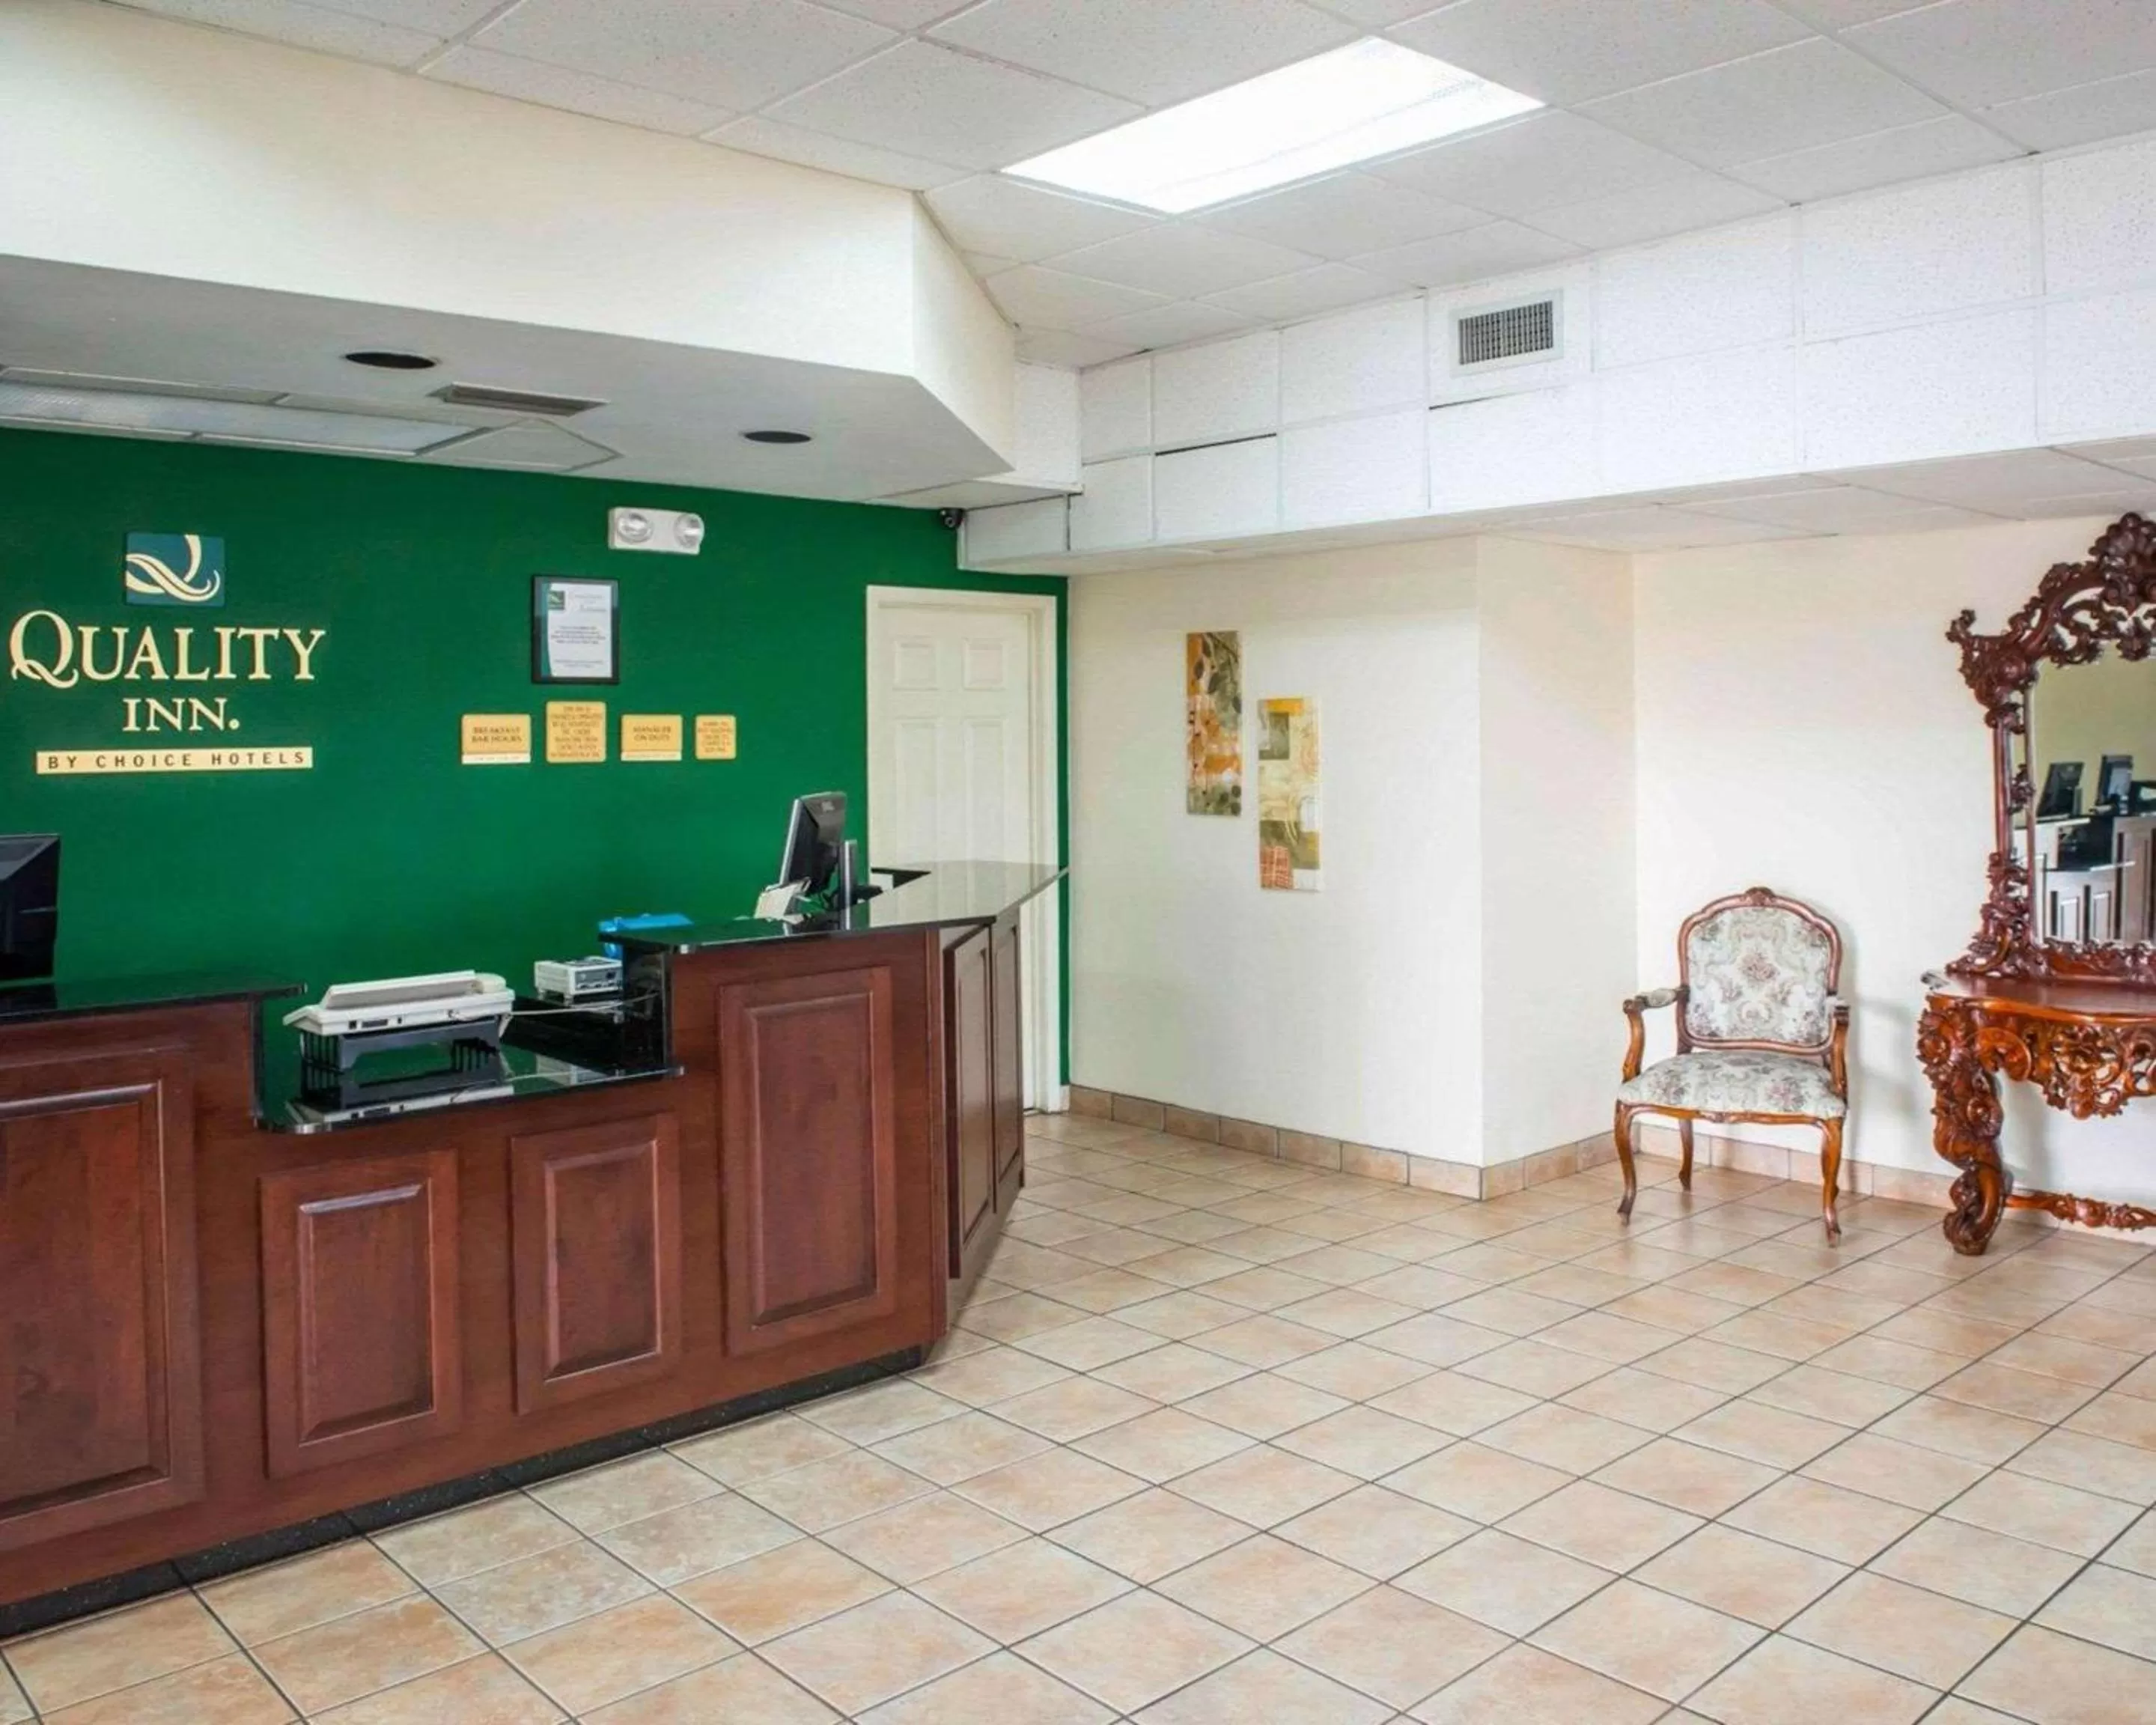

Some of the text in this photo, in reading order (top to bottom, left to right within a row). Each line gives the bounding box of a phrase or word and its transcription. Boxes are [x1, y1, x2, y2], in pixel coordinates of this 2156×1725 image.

[10, 610, 326, 688] QUALITY
[48, 751, 305, 769] BY CHOICE HOTELS
